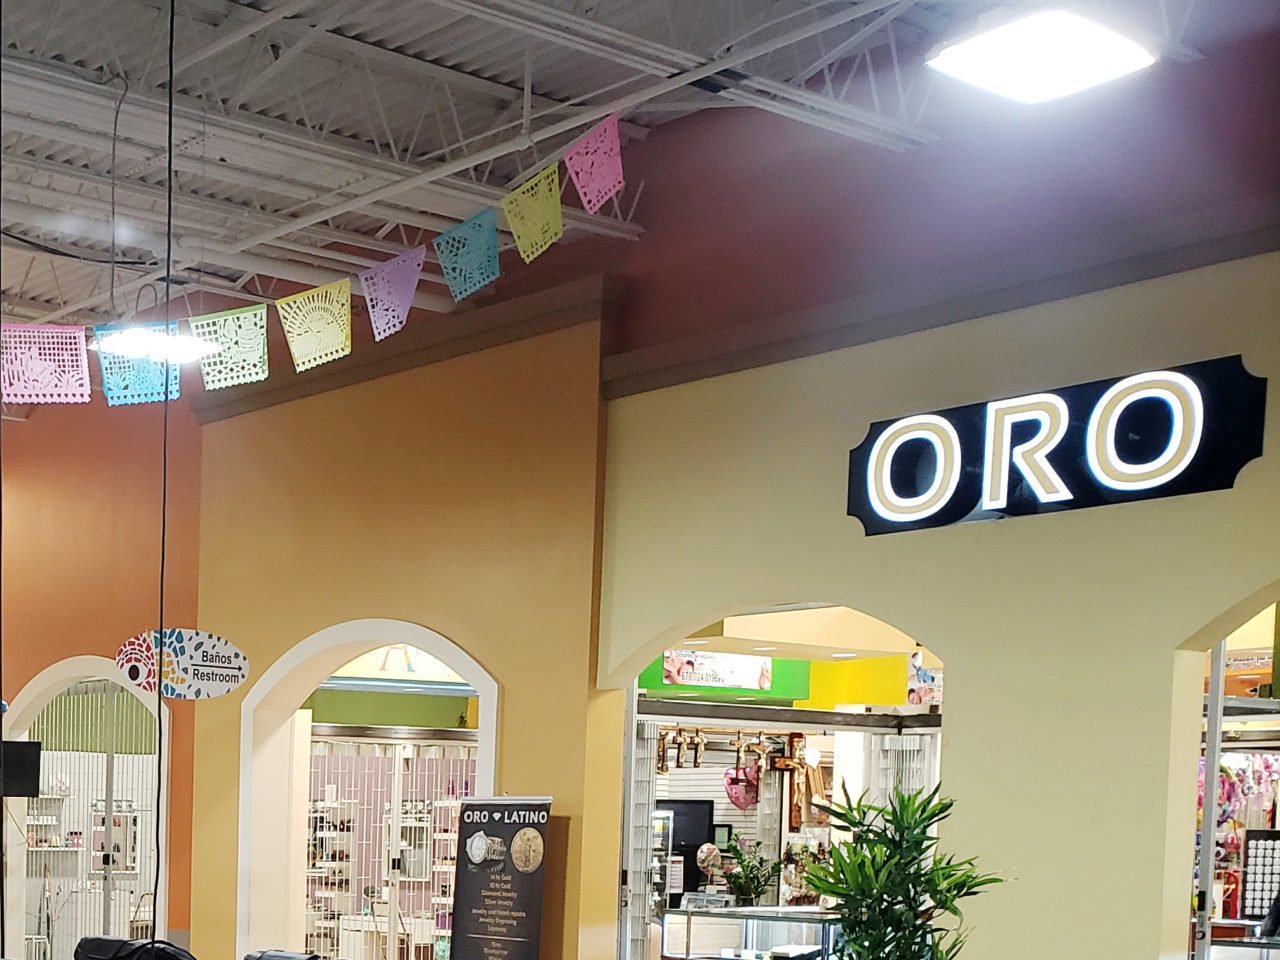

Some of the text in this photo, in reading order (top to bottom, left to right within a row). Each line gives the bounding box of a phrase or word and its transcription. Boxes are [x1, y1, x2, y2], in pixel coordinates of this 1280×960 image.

[866, 370, 1204, 523] ORO
[201, 650, 232, 665] Baños
[192, 668, 240, 684] Restroom
[463, 810, 547, 824] ORO LATINO
